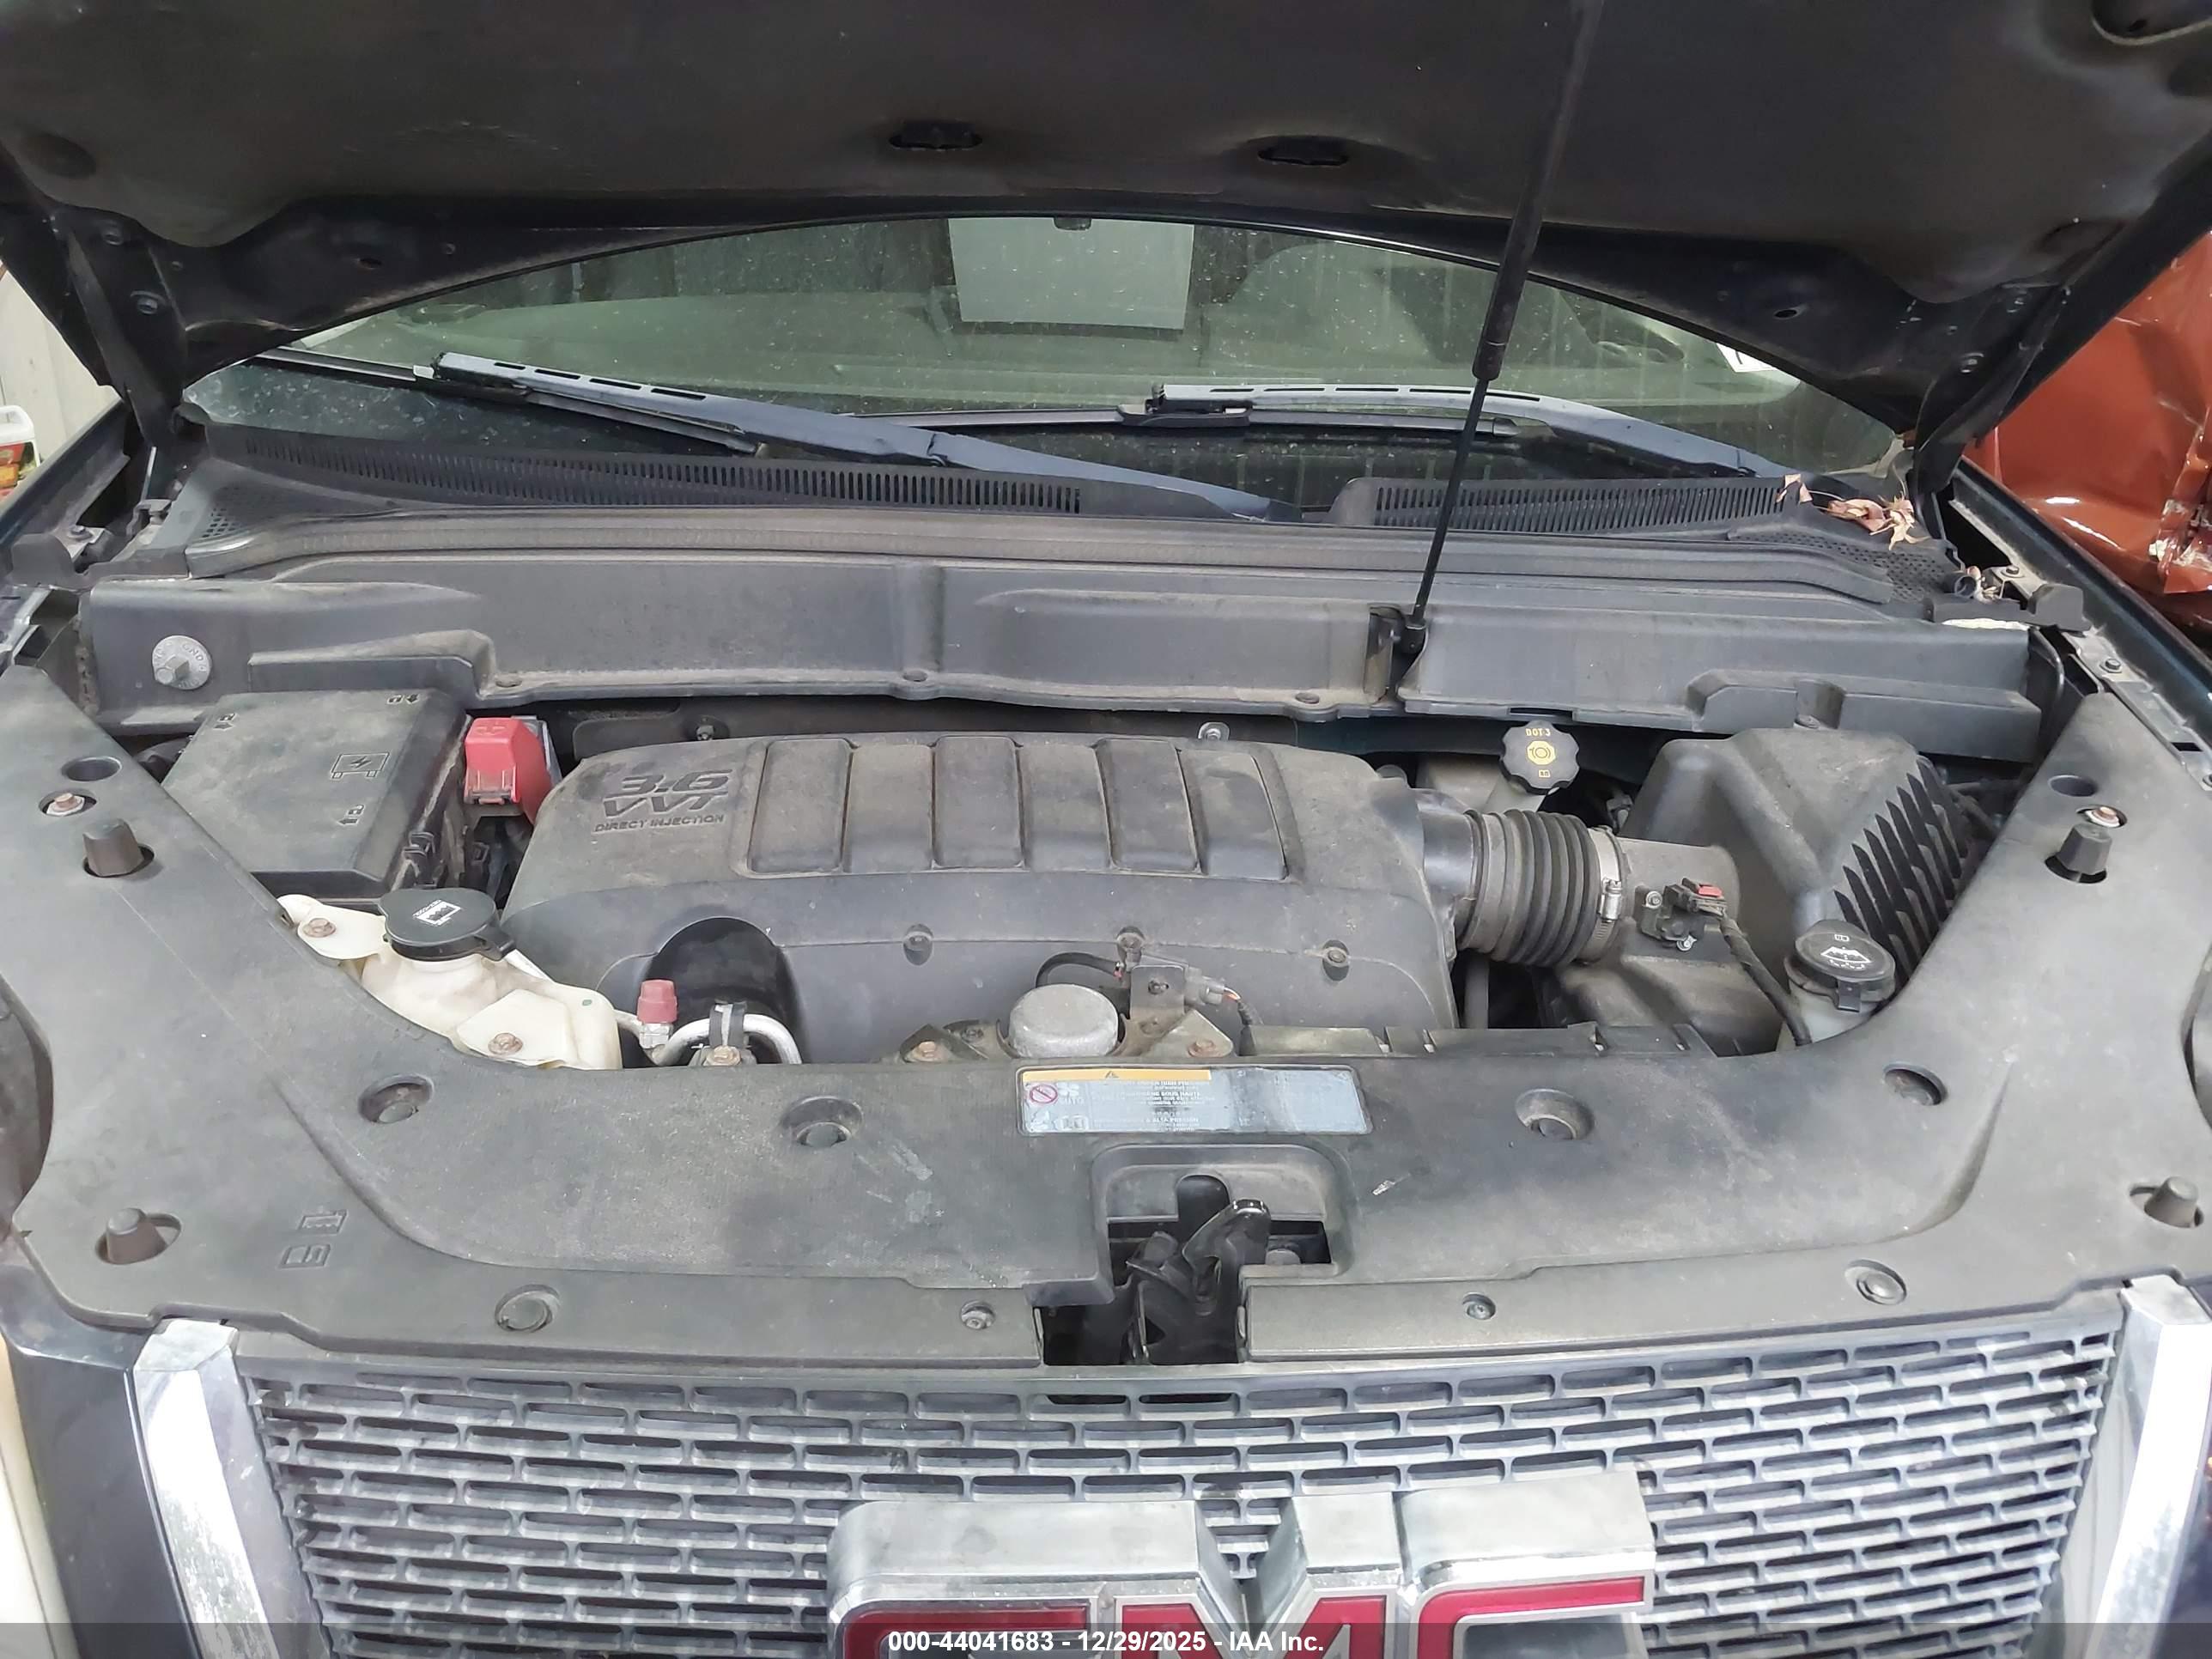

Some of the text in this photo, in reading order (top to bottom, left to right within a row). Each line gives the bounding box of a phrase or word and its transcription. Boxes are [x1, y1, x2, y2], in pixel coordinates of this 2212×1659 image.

[604, 791, 729, 817] VVT
[594, 814, 725, 833] DIRECT INJECTION
